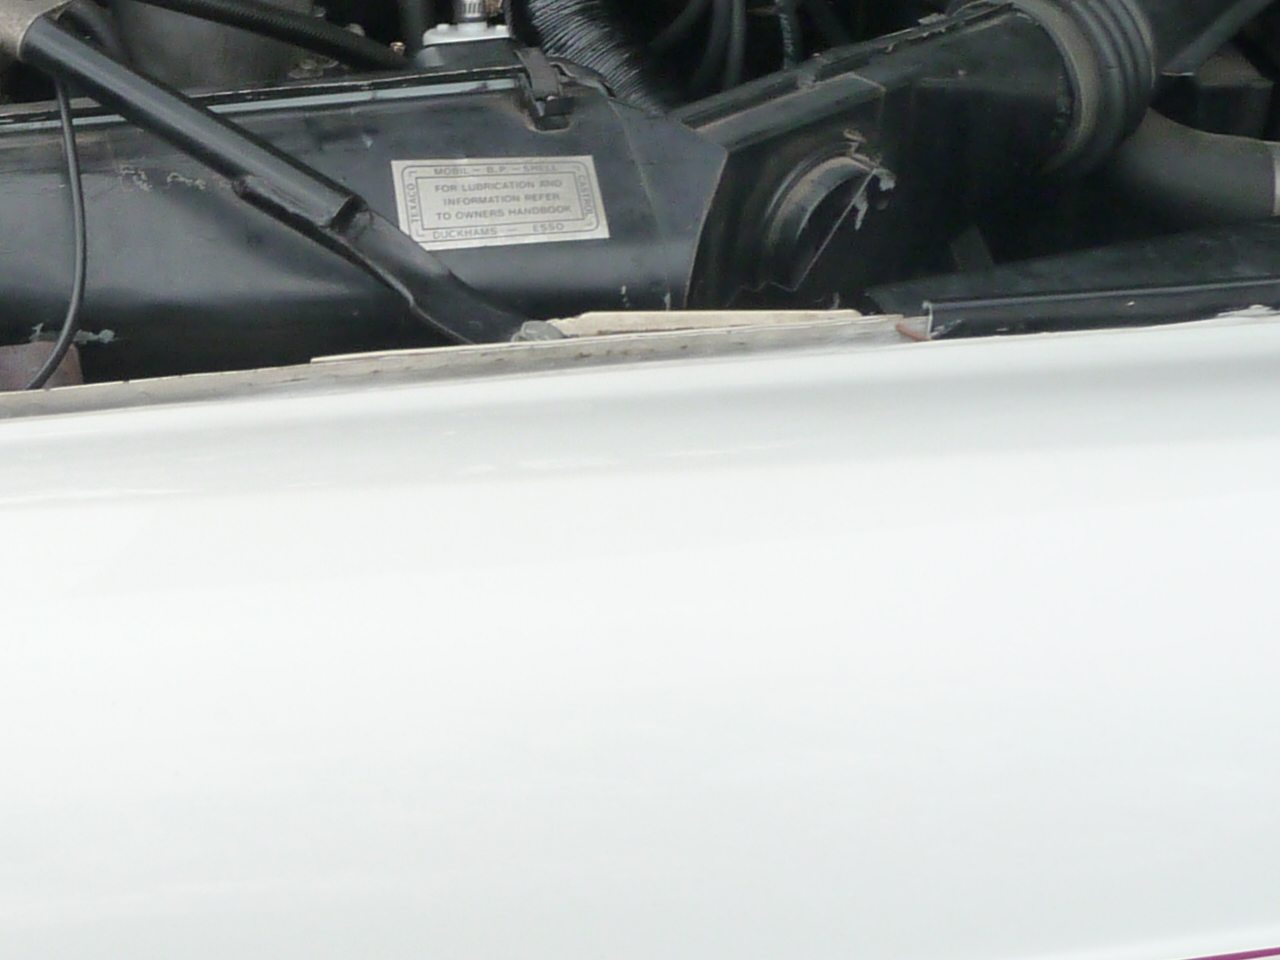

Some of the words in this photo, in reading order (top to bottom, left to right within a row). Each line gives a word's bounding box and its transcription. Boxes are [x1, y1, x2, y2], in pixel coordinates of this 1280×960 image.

[433, 167, 469, 176] MOBIL
[522, 164, 558, 172] SHELL
[435, 184, 457, 193] FOR
[462, 180, 535, 192] LUBRICATION
[539, 179, 563, 189] AND
[407, 183, 419, 223] TEXACO
[443, 195, 520, 206] INFORMATION
[524, 193, 561, 202] REFER
[578, 175, 593, 216] CASTROL
[436, 212, 451, 221] TO
[455, 208, 505, 219] OWNERS
[508, 205, 572, 217] HANDBOOK
[433, 227, 498, 239] DUCKHAMS
[533, 223, 565, 232] ESSO
